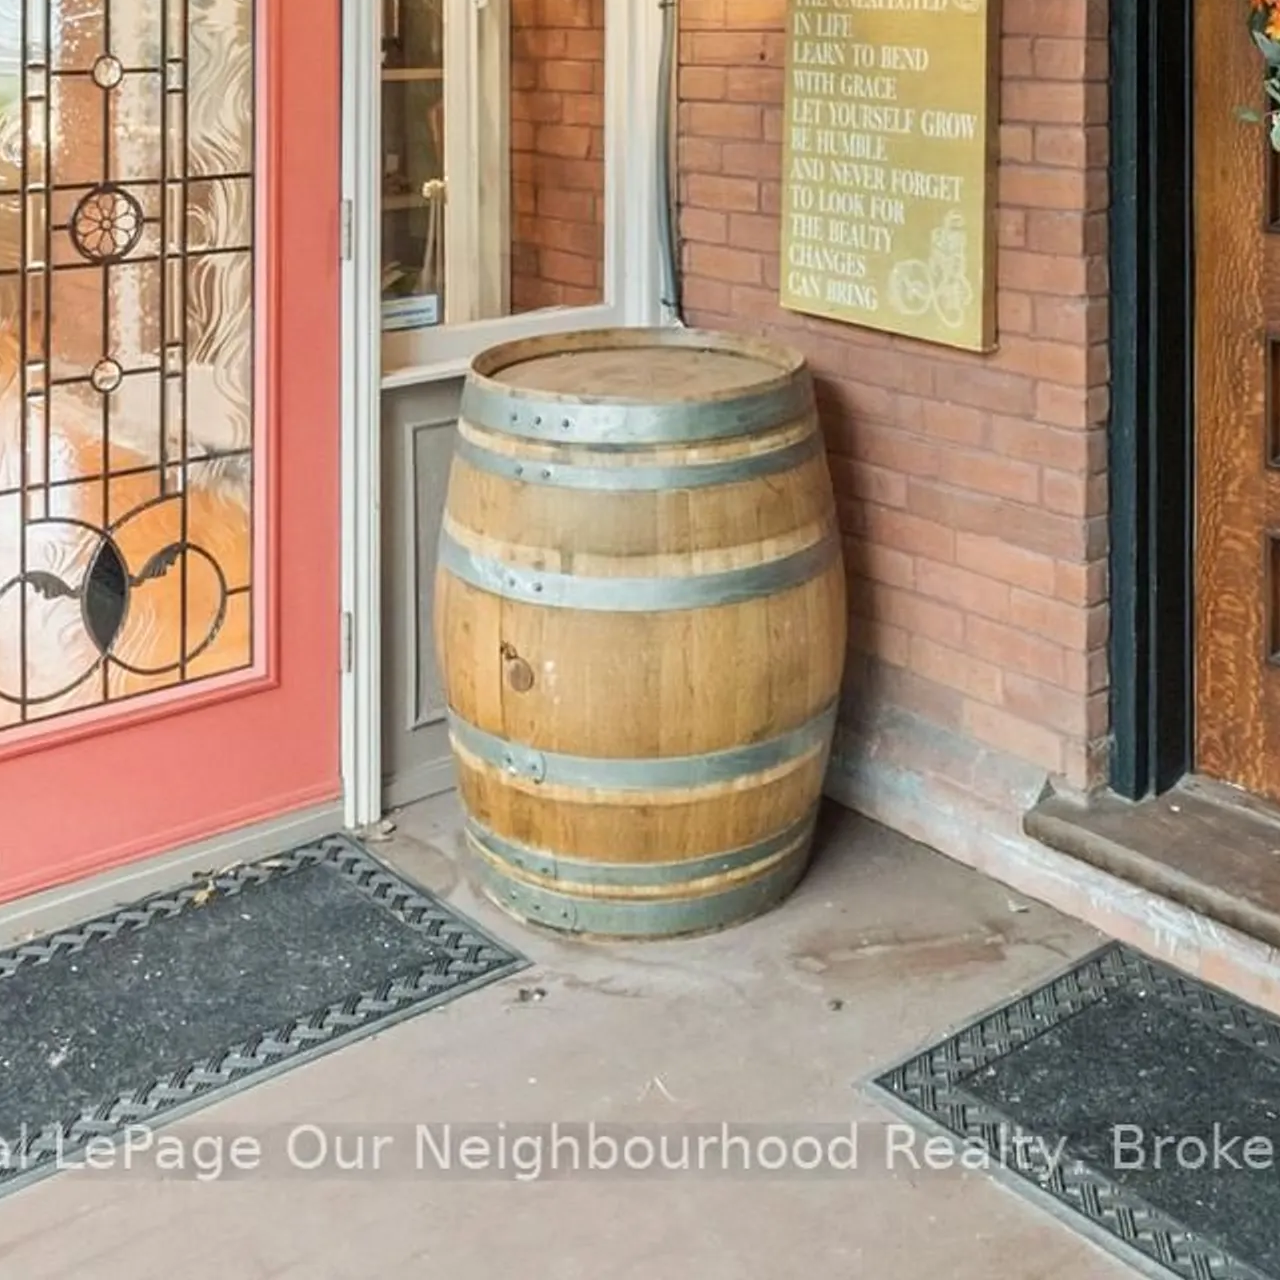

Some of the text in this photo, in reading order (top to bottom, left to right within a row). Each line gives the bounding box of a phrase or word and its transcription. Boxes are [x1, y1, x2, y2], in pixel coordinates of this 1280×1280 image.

[795, 13, 853, 36] IN LIFE
[795, 42, 929, 70] LEARN TO BEND
[794, 71, 897, 98] WITH GRACE
[793, 99, 977, 138] LET YOURSELF GROW
[792, 127, 888, 160] BE HUMBLE
[791, 158, 963, 201] AND NEVER FORGET
[791, 186, 906, 224] TO LOOK FOR
[791, 215, 894, 252] THE BEAUTY
[789, 244, 867, 275] CHANGES
[789, 272, 878, 311] CAN BRING
